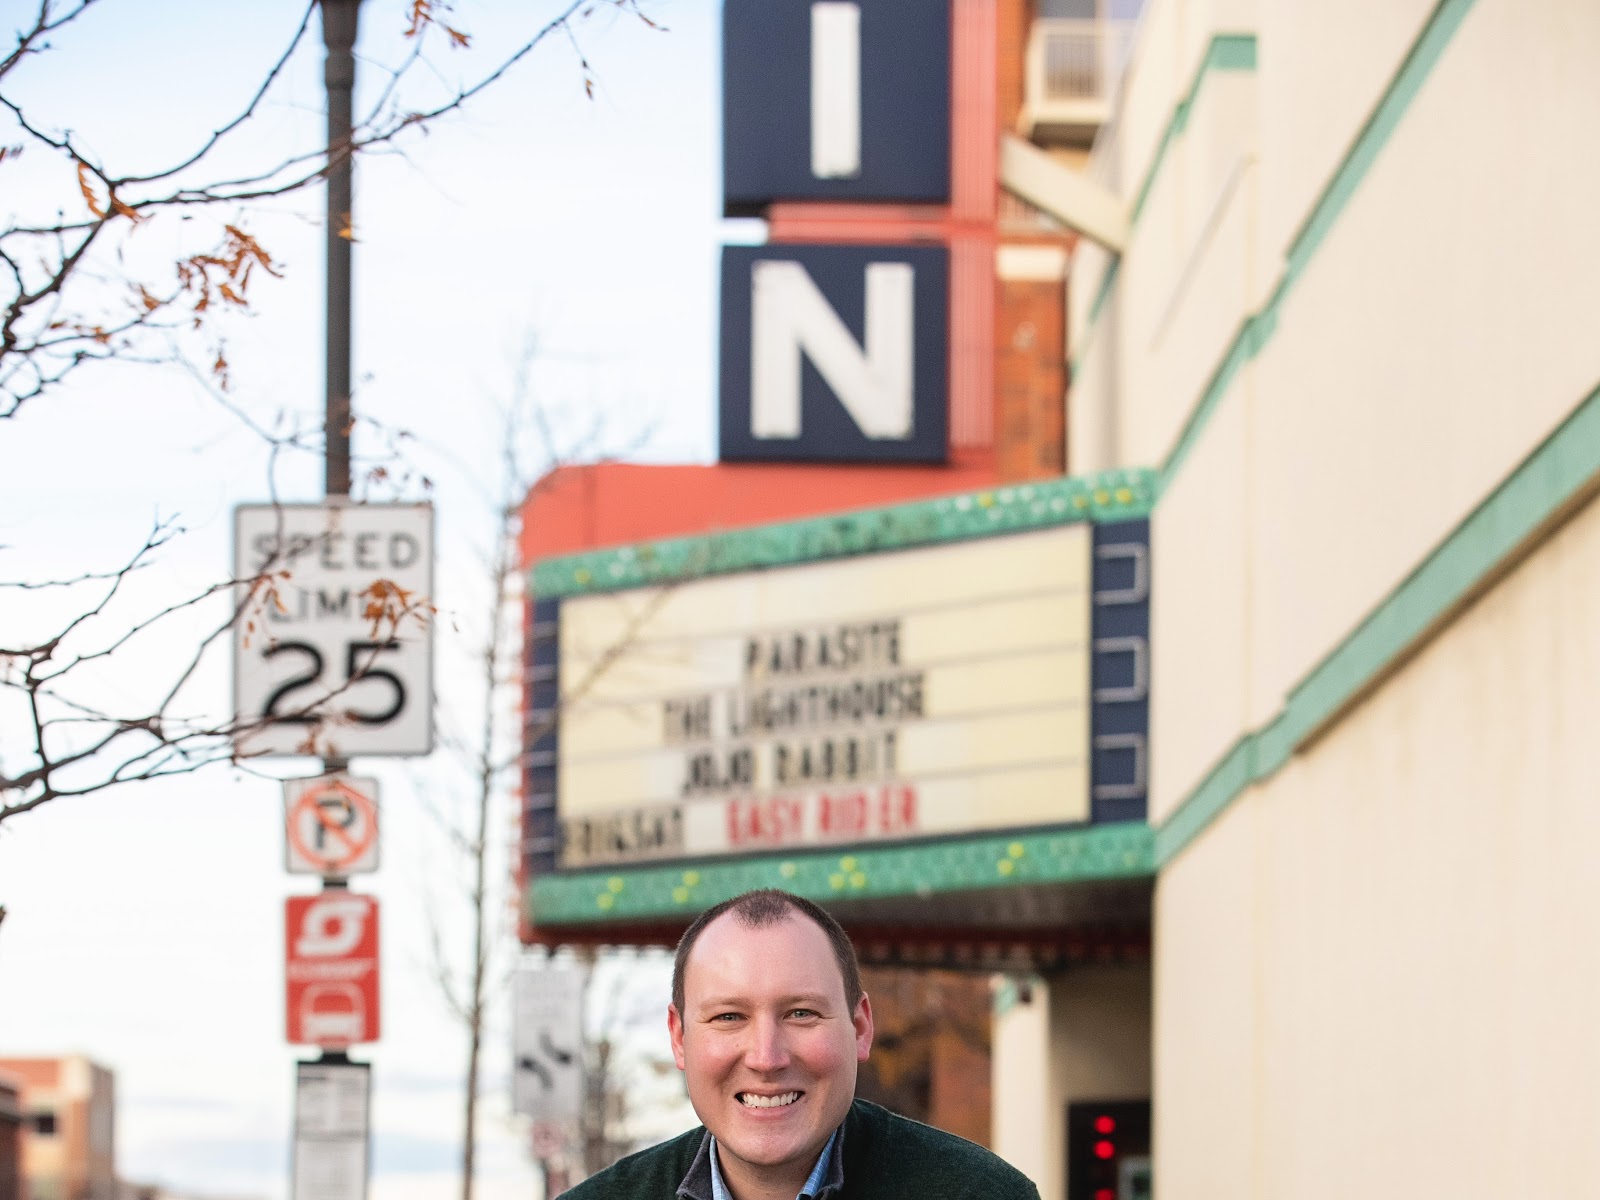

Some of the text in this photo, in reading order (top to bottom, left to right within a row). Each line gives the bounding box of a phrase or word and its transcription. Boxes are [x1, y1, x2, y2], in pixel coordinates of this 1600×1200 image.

[252, 532, 420, 570] SPEED
[746, 620, 900, 675] PARASITE
[261, 640, 406, 725] 25
[663, 671, 925, 739] THE LIGHTHOUSE
[682, 729, 898, 796] JOJO RABBIT
[725, 796, 803, 845] EASY
[817, 782, 920, 836] RIDER
